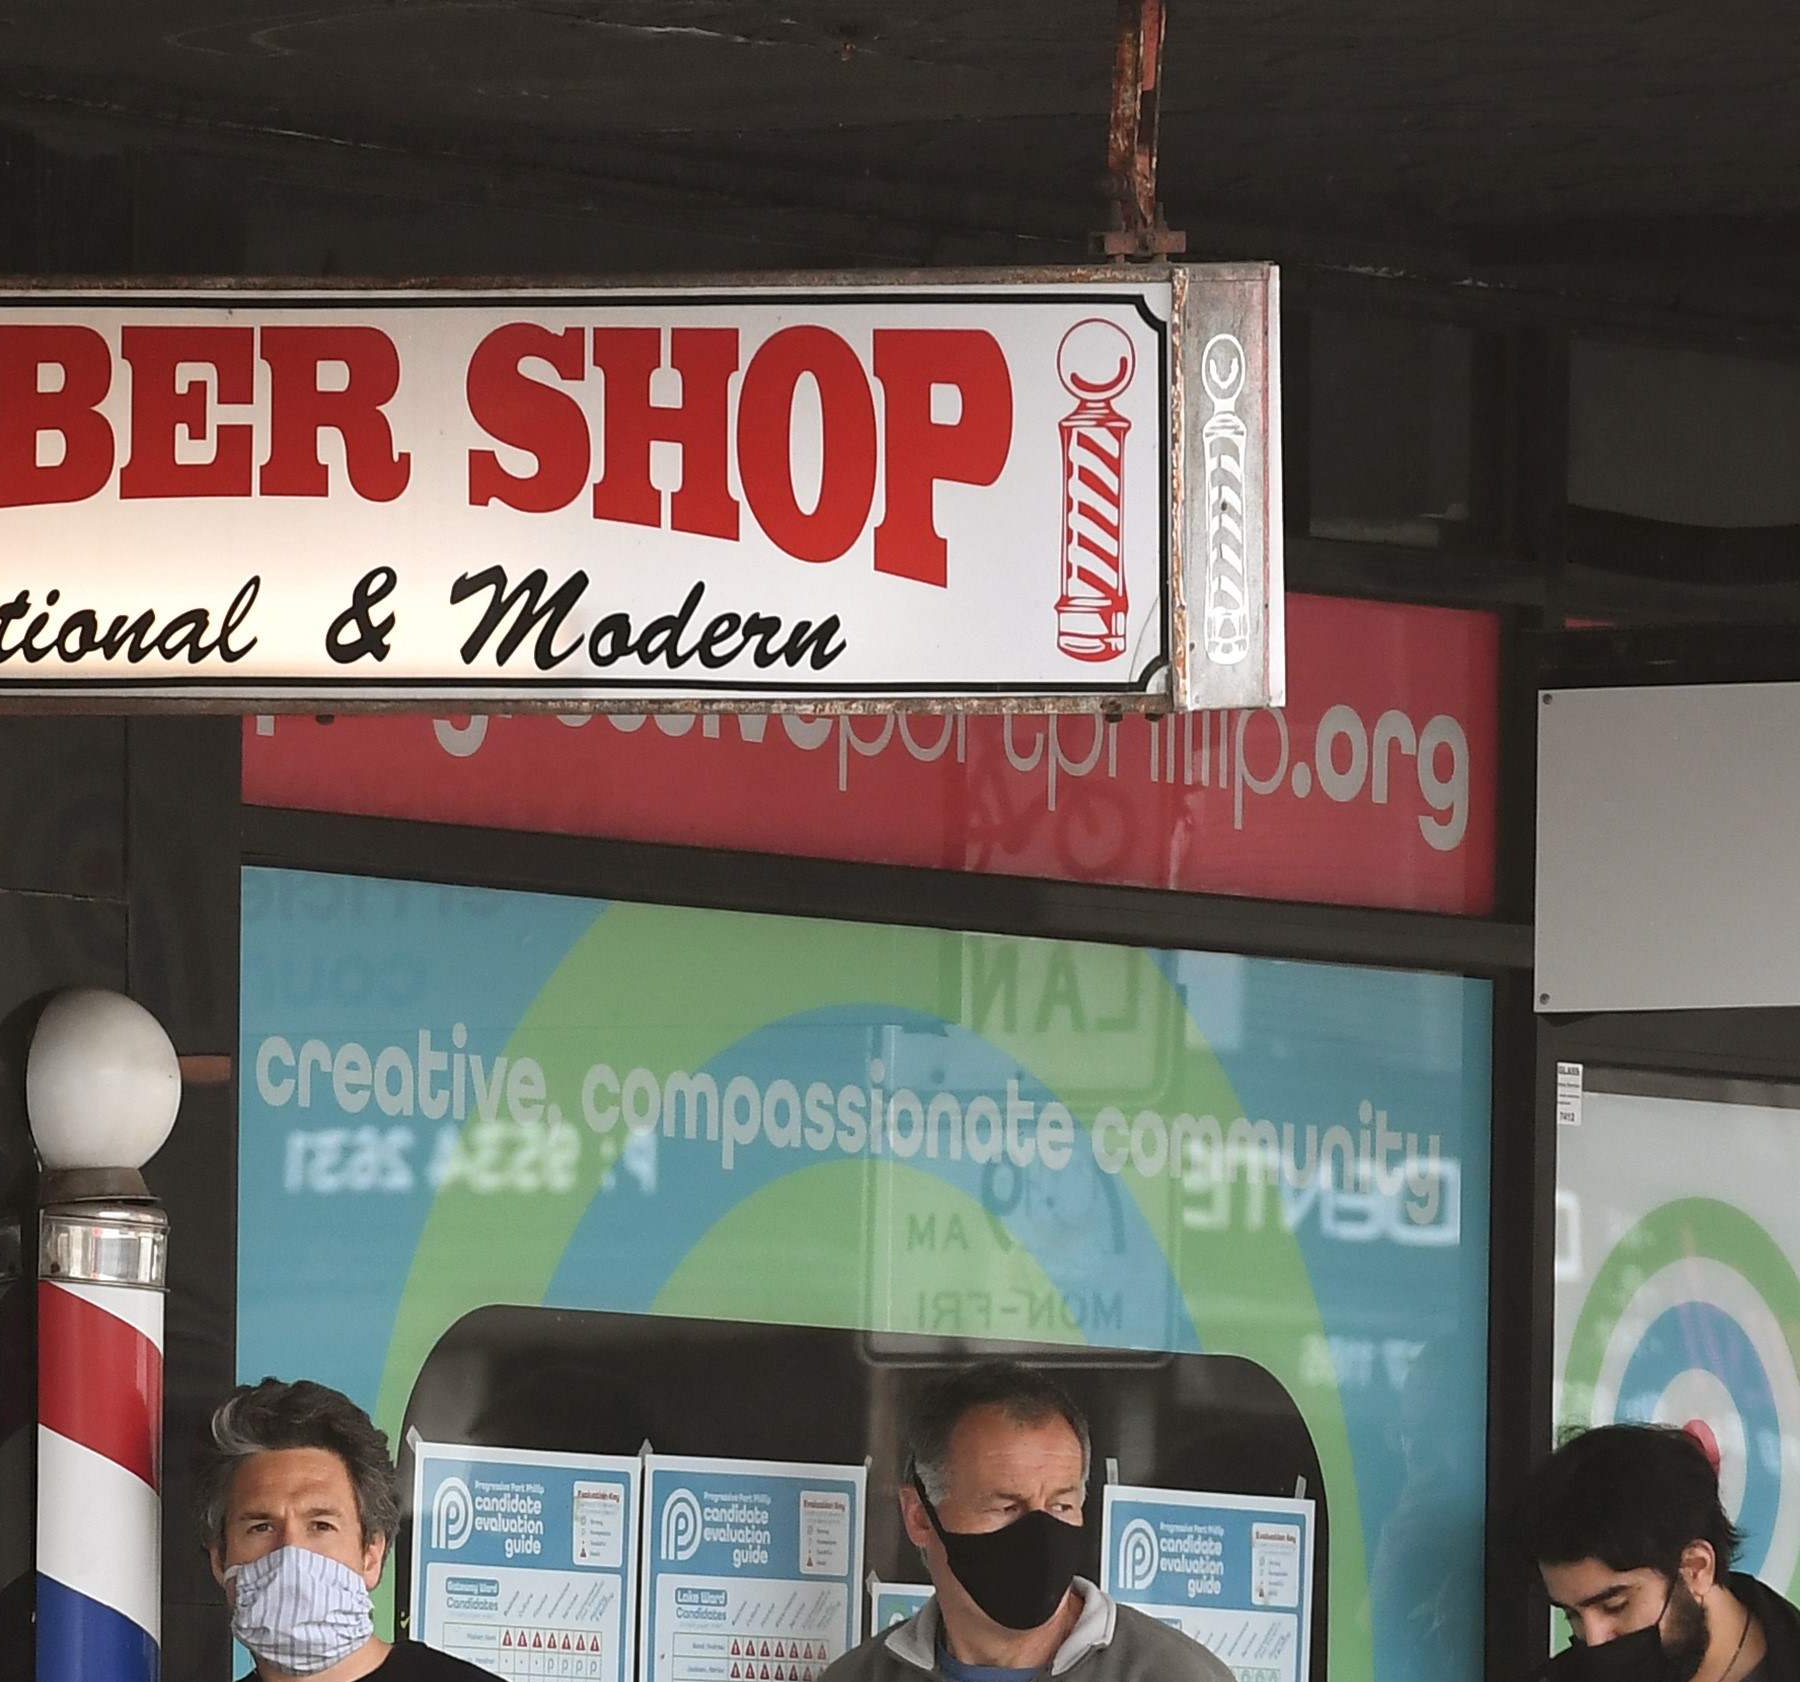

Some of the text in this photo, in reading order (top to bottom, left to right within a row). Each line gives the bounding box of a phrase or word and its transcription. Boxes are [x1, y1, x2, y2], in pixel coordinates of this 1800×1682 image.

[467, 319, 1014, 588] SHOP
[323, 568, 398, 661] &
[449, 564, 848, 671] Modern
[256, 1022, 563, 1136] creative,
[582, 1058, 1075, 1170] compassionate
[1092, 1099, 1441, 1224] community
[474, 1492, 542, 1515] candidate
[703, 1503, 769, 1524] candidate
[474, 1513, 544, 1534] evaluation
[703, 1524, 771, 1544] evaluation
[504, 1535, 542, 1558] guide
[733, 1545, 768, 1568] guide
[1159, 1534, 1222, 1556] candidate
[1159, 1554, 1224, 1576] evaluation
[1187, 1575, 1221, 1599] guide
